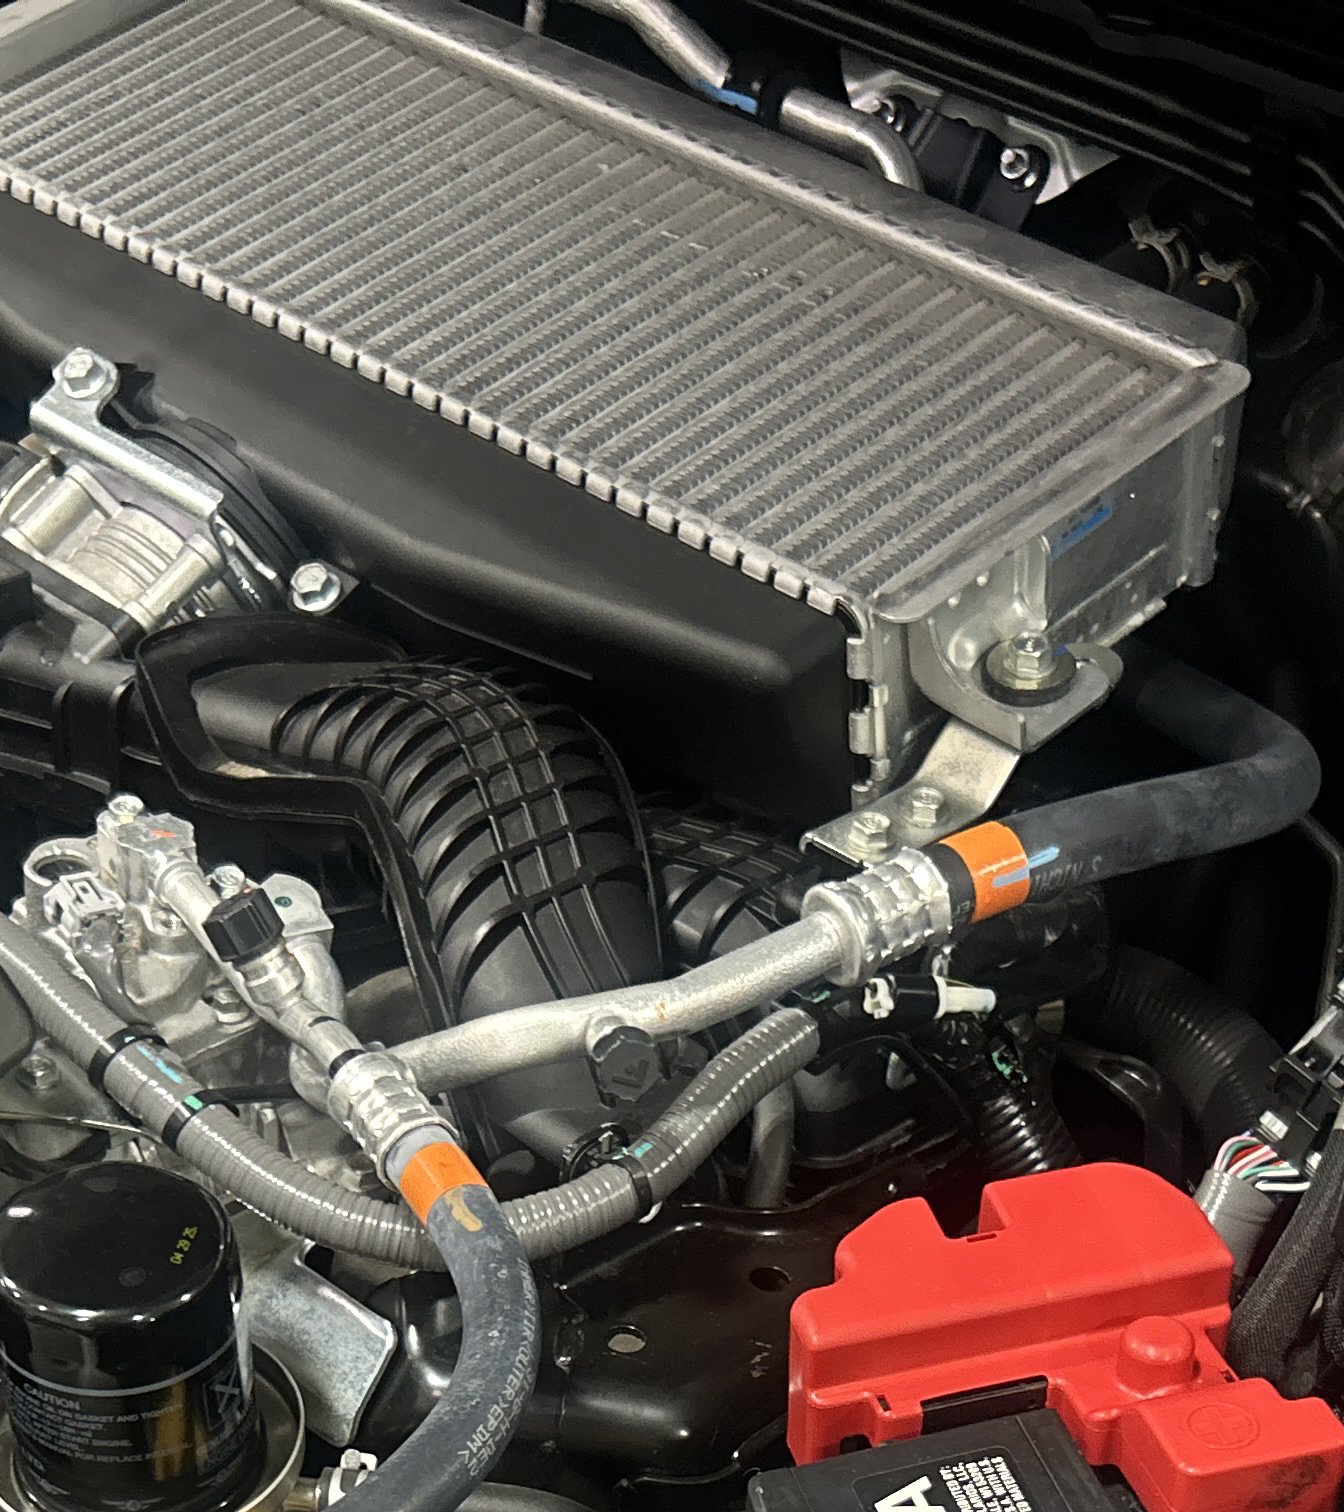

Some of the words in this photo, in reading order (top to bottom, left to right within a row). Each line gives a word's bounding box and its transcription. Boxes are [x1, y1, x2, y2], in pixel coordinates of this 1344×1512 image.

[22, 1382, 81, 1410] CAUTION
[985, 1474, 1005, 1495] WITH
[991, 1456, 1025, 1502] MATERIALS
